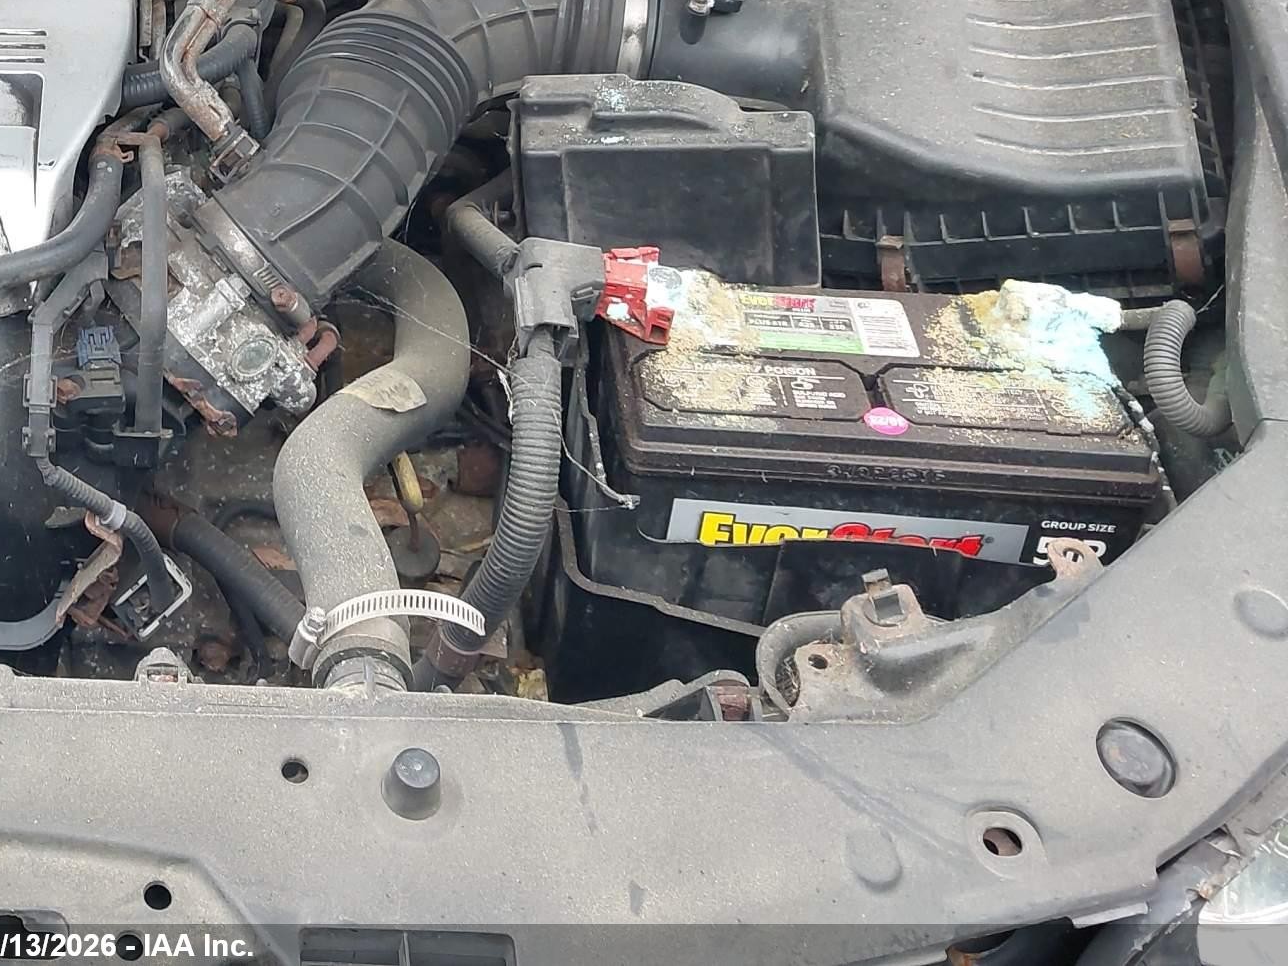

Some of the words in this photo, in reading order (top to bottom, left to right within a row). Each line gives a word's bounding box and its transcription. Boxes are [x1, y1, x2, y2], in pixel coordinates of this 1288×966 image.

[764, 365, 816, 376] POISON
[1041, 520, 1086, 531] GROUP
[1087, 523, 1117, 533] SIZE
